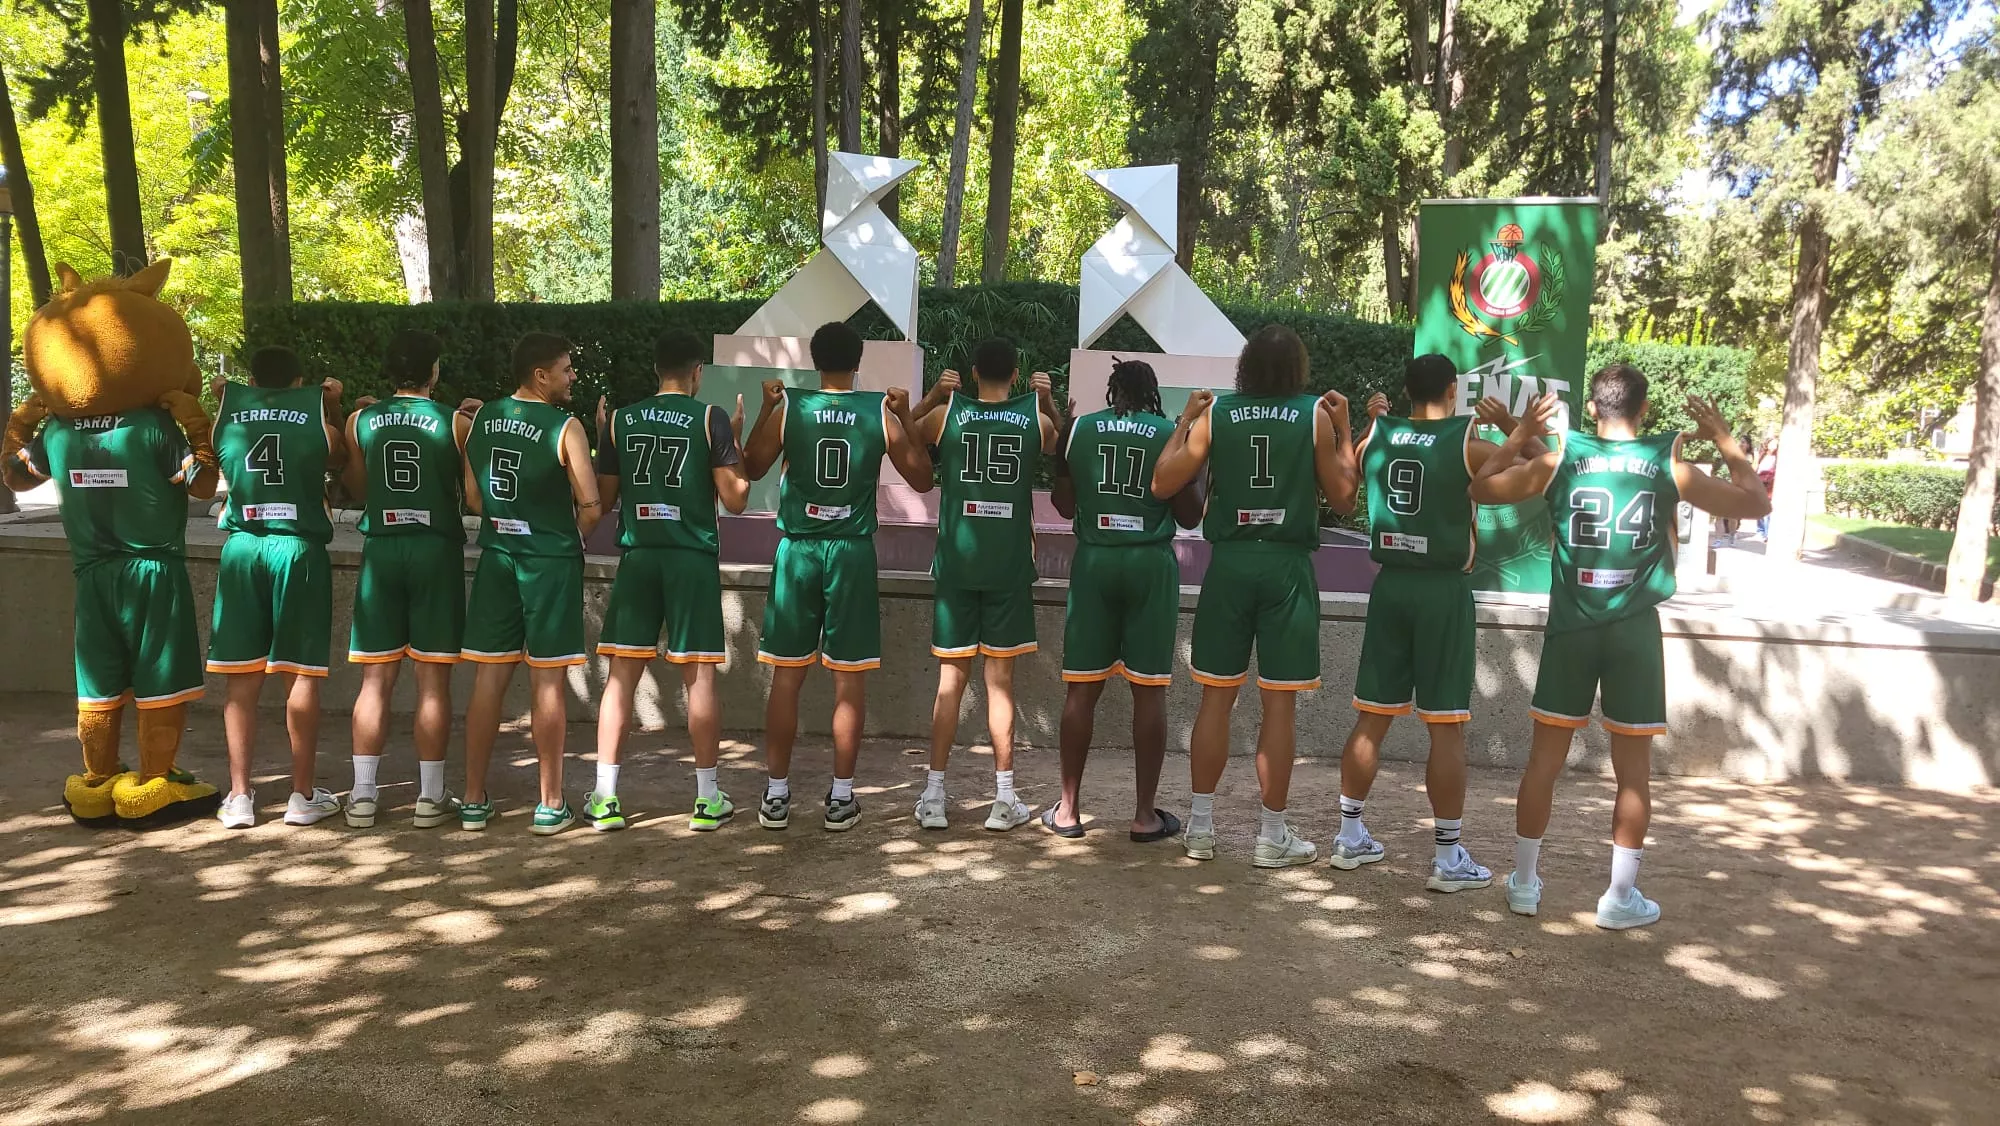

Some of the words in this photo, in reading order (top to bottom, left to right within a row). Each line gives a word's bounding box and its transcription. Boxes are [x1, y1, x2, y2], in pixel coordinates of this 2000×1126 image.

[73, 415, 125, 431] SARRY
[230, 408, 309, 425] TERREROS
[369, 412, 439, 433] CORRALIZA
[484, 418, 543, 443] FIGUEROA
[625, 413, 637, 426] G.
[641, 407, 694, 429] VÁZQUEZ
[813, 410, 857, 426] THIAM
[1096, 420, 1157, 439] BADMUS
[1230, 406, 1300, 424] BIESHAAR
[1391, 432, 1437, 447] KREPS
[244, 433, 285, 486] 4
[383, 440, 421, 493] 6
[489, 447, 522, 502] 5
[626, 433, 690, 488] 77
[815, 437, 851, 489] 0
[960, 431, 1023, 485] 15
[1098, 443, 1145, 499] 11
[1250, 435, 1275, 488] 1
[1387, 458, 1425, 516] 9
[1569, 486, 1656, 550] 24
